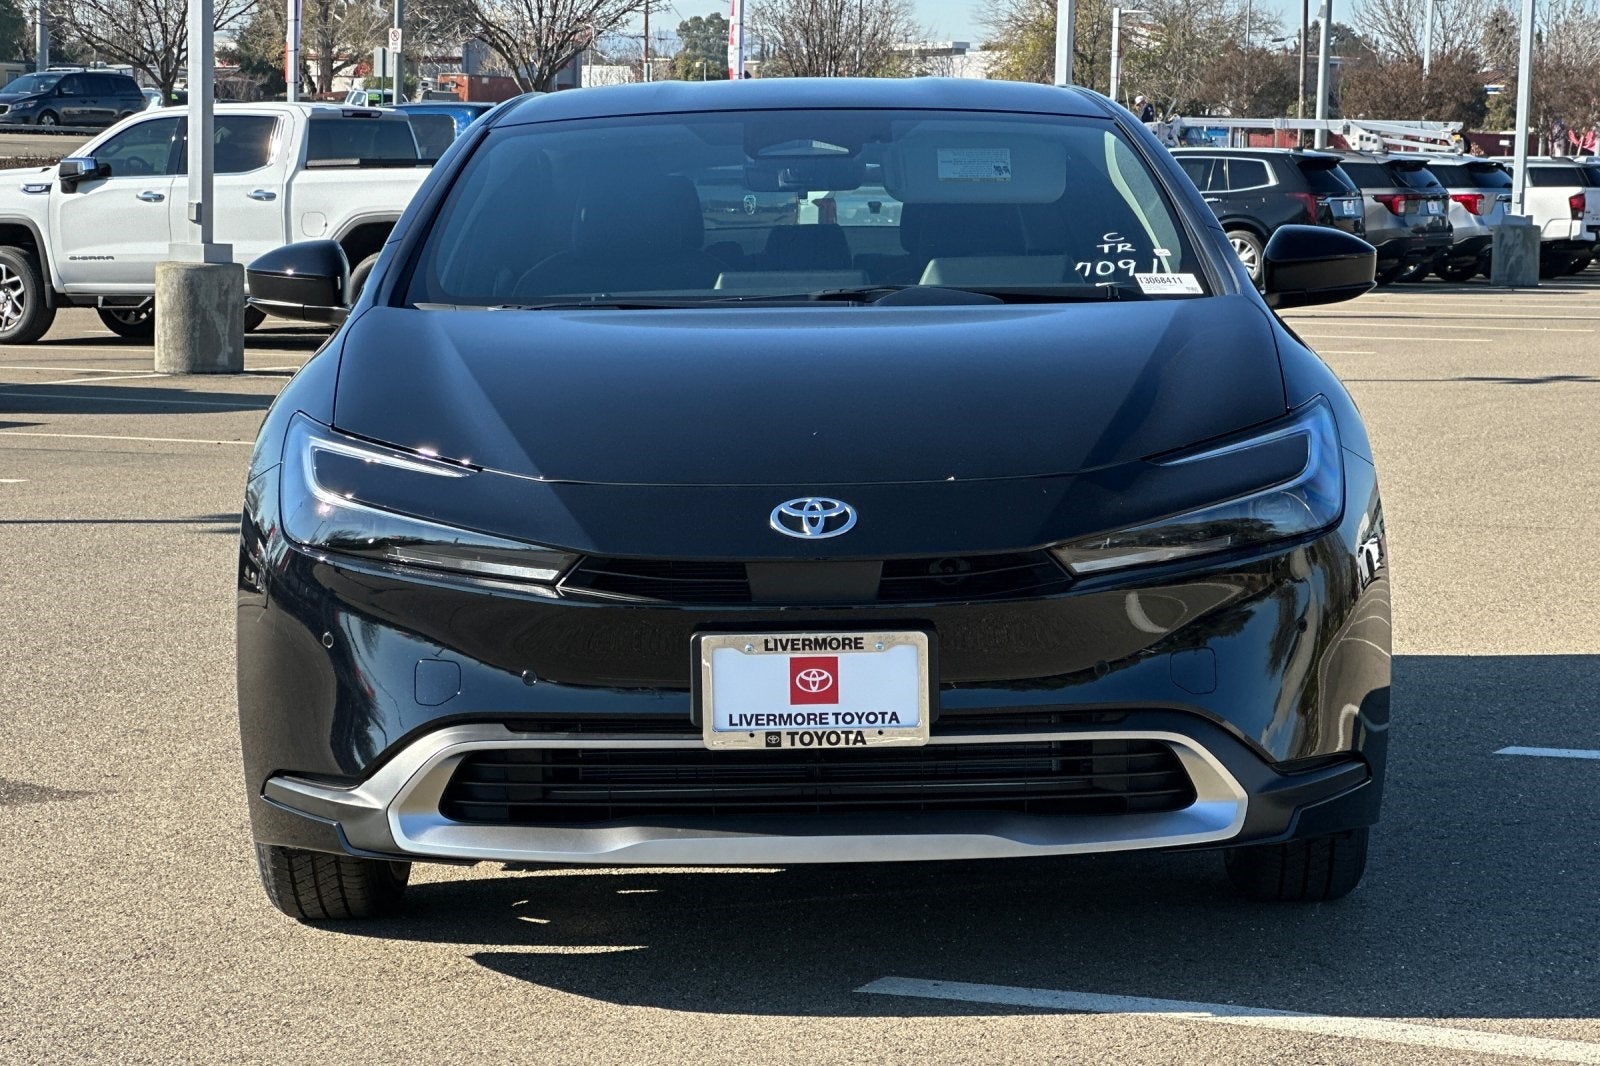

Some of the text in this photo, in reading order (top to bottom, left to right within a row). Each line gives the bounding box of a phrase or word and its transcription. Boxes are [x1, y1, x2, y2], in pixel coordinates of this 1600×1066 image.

[1096, 243, 1136, 254] TR
[764, 637, 864, 652] LIVERMORE
[728, 711, 901, 727] LIVERMORE TOYOTA
[786, 731, 867, 747] TOYOTA
